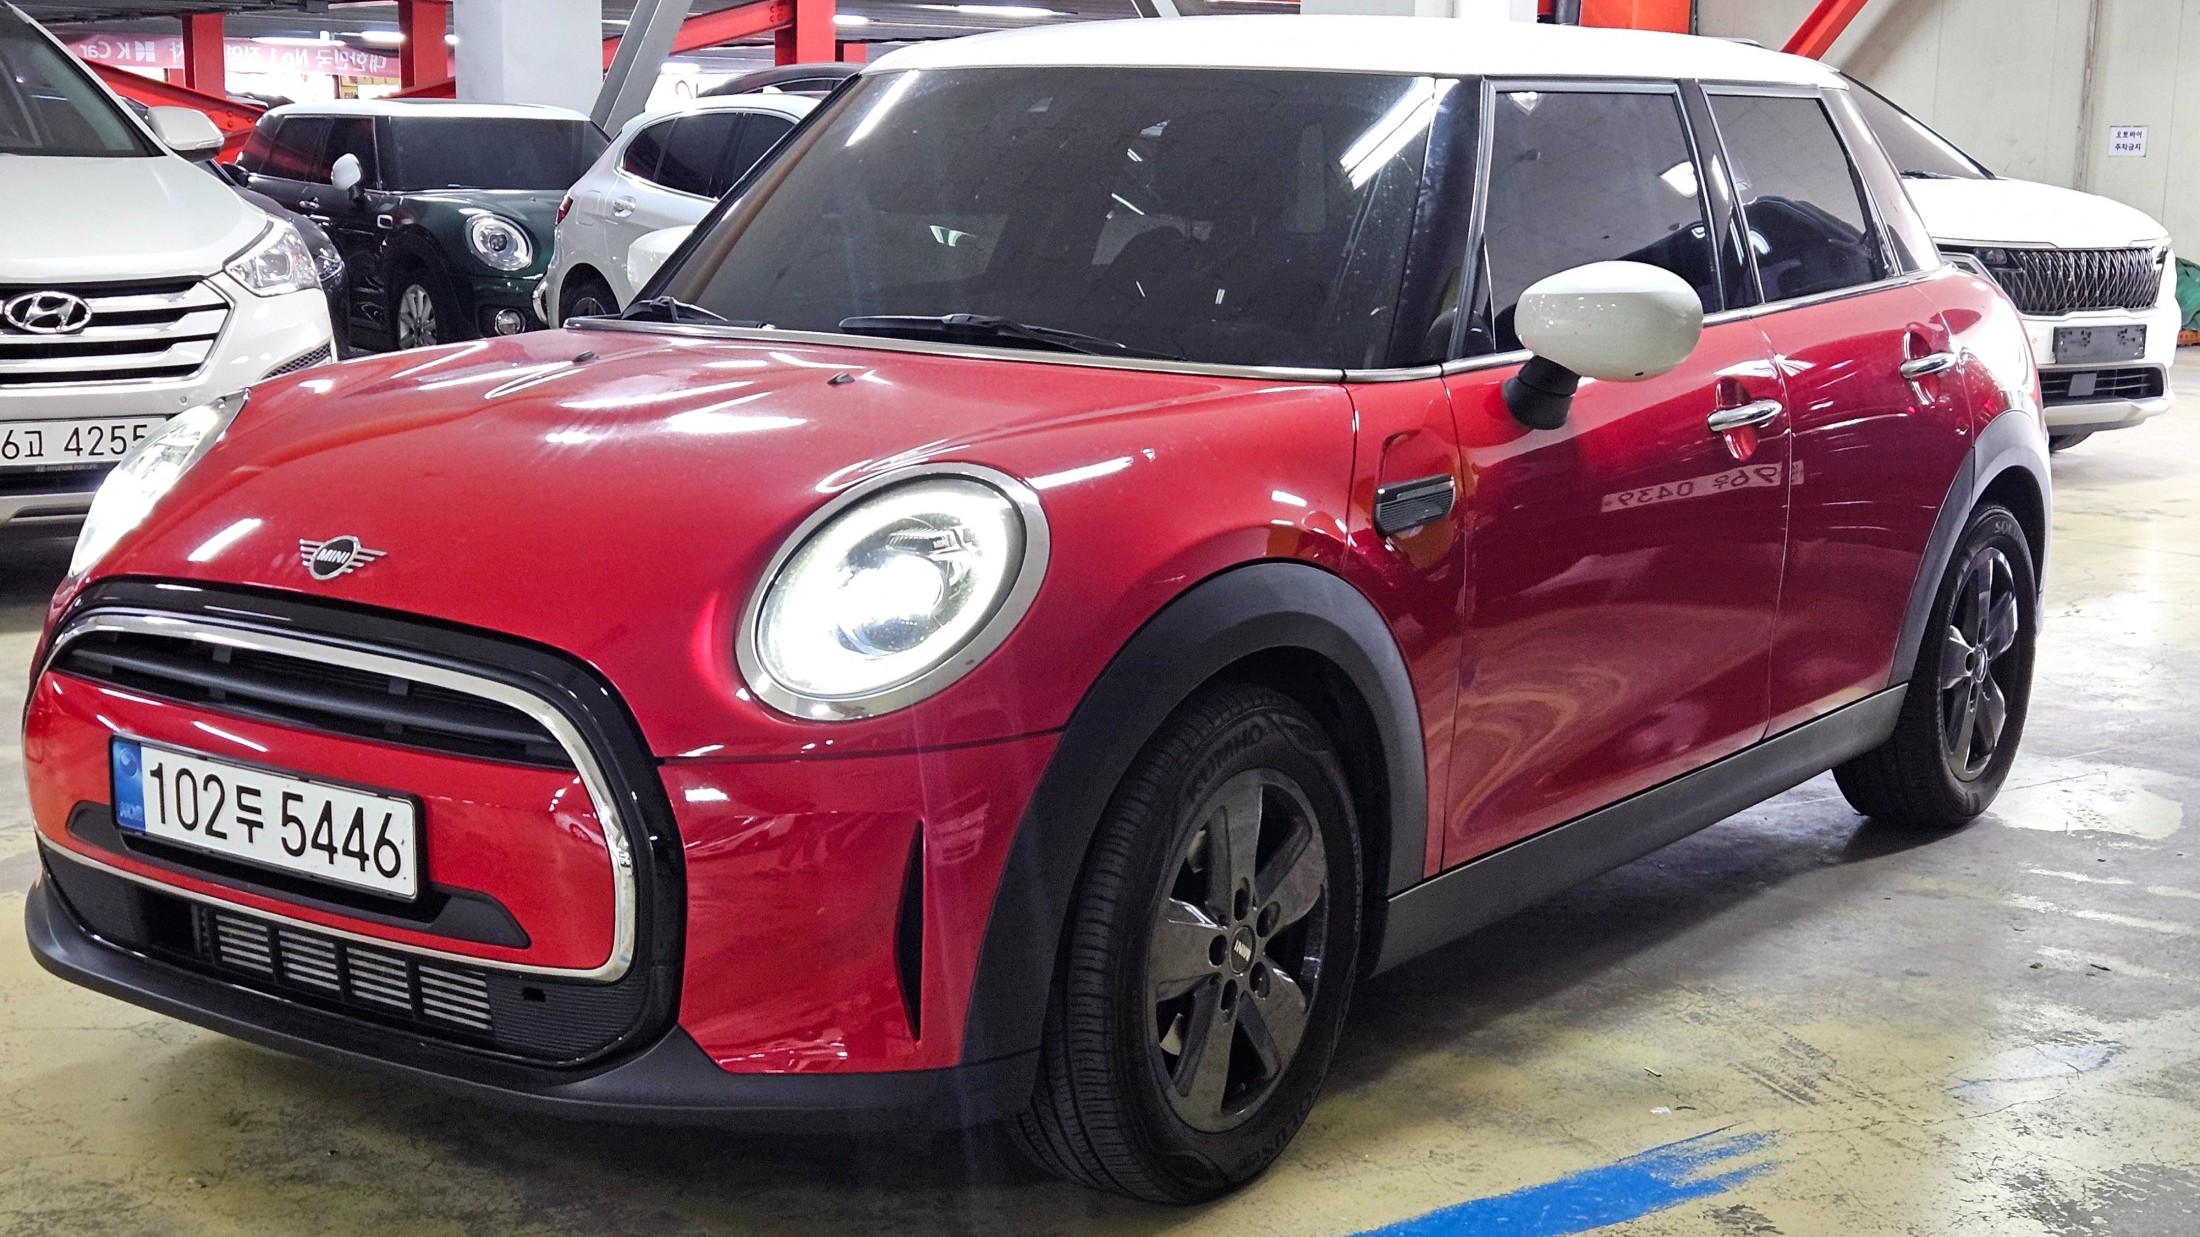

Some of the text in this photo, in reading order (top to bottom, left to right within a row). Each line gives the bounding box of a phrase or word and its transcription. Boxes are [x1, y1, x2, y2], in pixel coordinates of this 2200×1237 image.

[2114, 143, 2141, 151] 주차금지
[316, 548, 352, 565] MINI
[148, 760, 402, 879] 102두 5446
[1233, 938, 1252, 962] MINI
